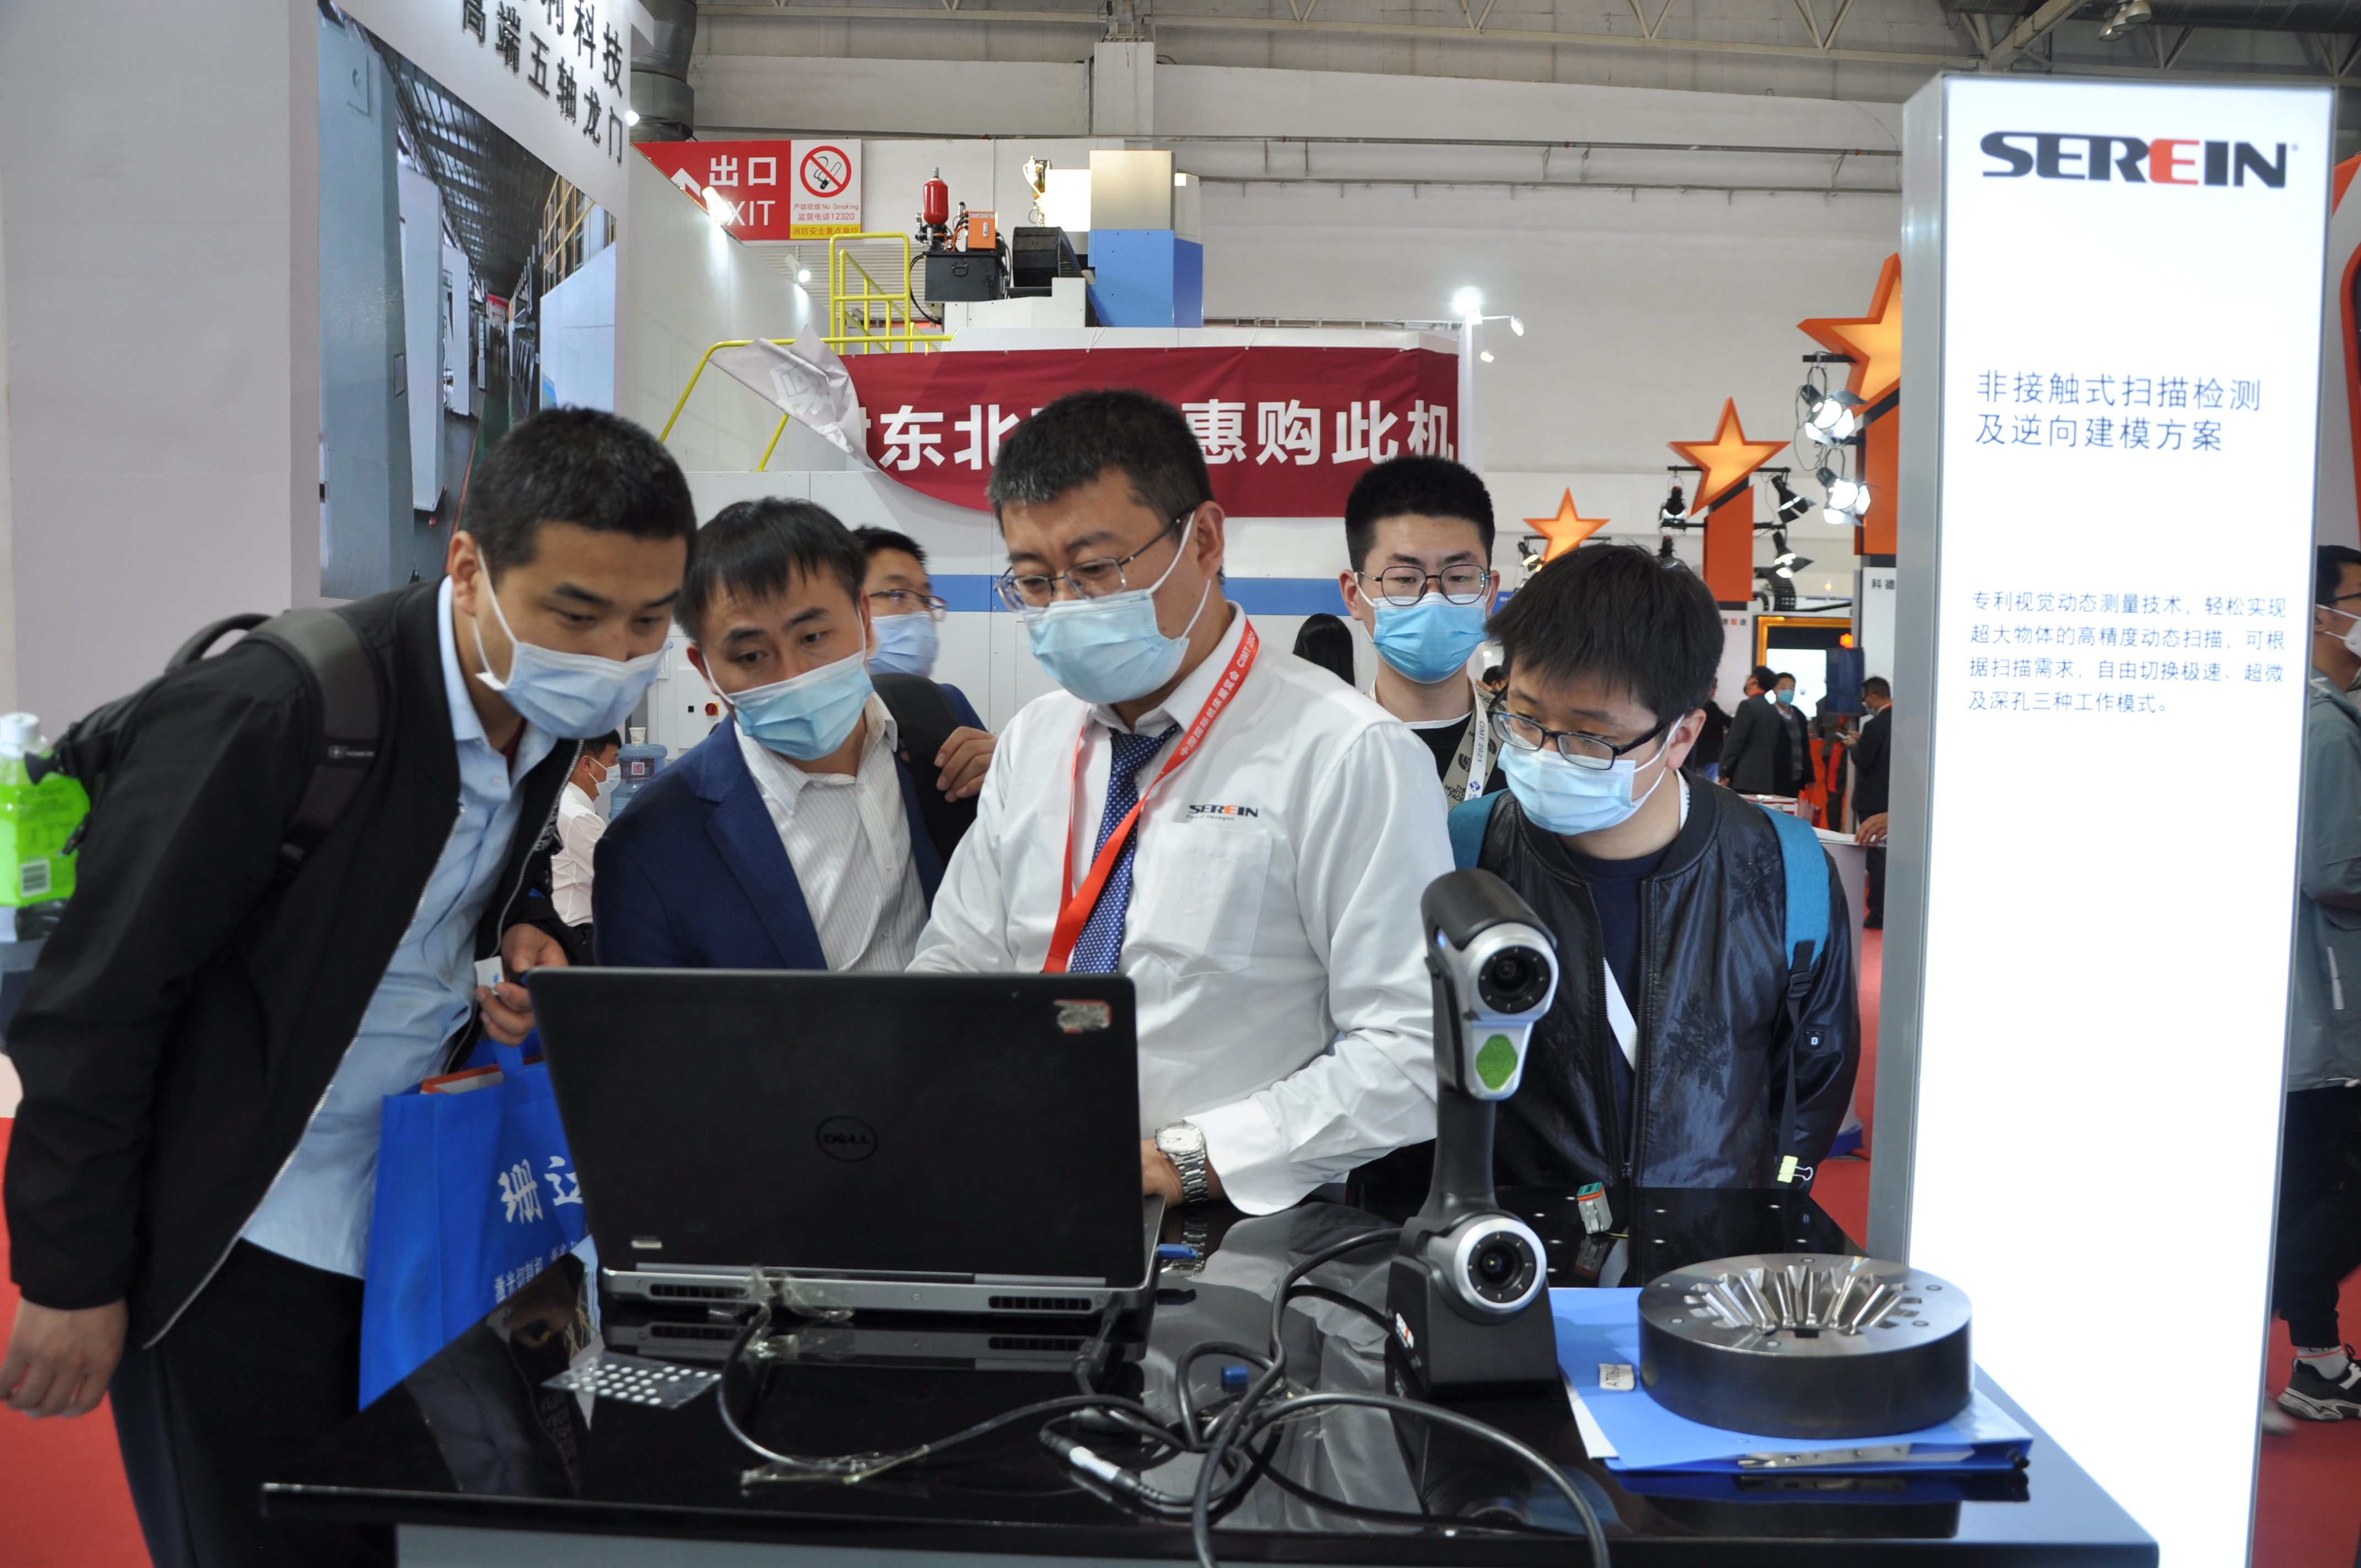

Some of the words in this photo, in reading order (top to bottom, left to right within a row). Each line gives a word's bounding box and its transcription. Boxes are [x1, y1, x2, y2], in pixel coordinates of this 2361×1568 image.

[709, 155, 777, 187] 出口
[1981, 132, 2287, 189] SEREIN
[726, 200, 776, 226] XIT
[792, 227, 859, 235] 消防安全重点单位
[1977, 369, 2261, 412] 非接触式扫描检测
[1976, 414, 2222, 452] 及逆向建模方案
[1180, 671, 1240, 758] 中国国际机床展览会
[1236, 646, 1252, 668] CIMT
[1476, 742, 1485, 763] 2021
[1189, 804, 1259, 818] SEREIN
[824, 1133, 871, 1145] DELL
